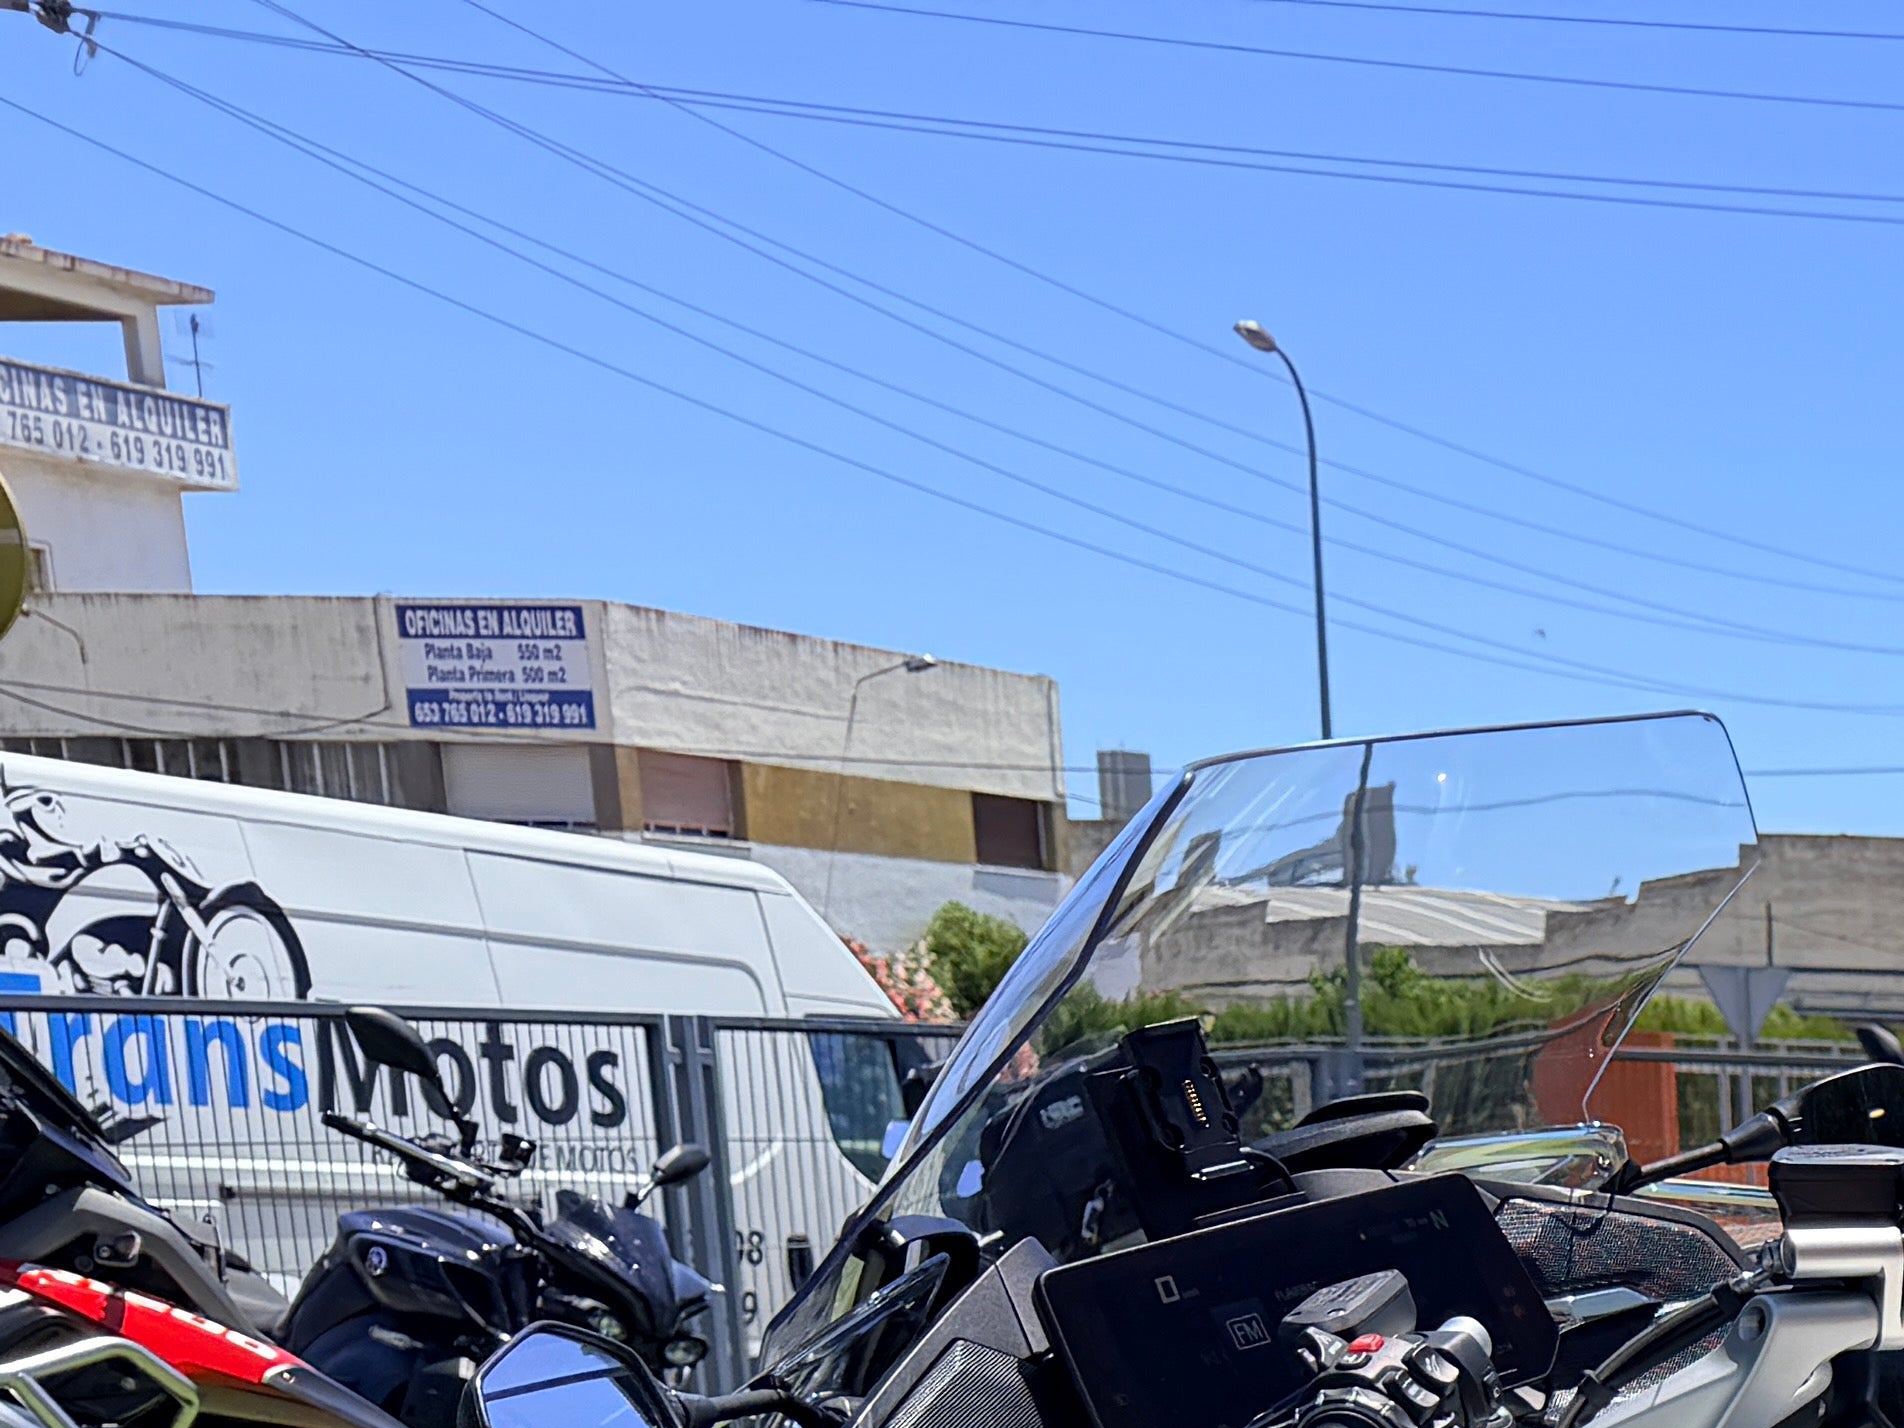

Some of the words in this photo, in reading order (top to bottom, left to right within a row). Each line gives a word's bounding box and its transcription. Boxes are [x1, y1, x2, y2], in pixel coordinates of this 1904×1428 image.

[76, 381, 107, 422] EN
[117, 388, 224, 446] ALQUILER
[7, 410, 44, 445] 765
[53, 419, 90, 453] 012
[111, 431, 145, 465] 619
[153, 439, 186, 472] 319
[194, 447, 226, 481] 991
[404, 609, 475, 636] OFICINAS
[477, 609, 499, 636] EN
[503, 609, 577, 637] ALQUILER
[424, 643, 463, 660] Planta
[466, 643, 493, 664] Baja
[427, 665, 466, 682] Planta
[468, 665, 516, 683] Primera
[414, 702, 440, 723] 653
[442, 702, 468, 723] 765
[470, 703, 496, 724] 012
[506, 703, 532, 724] 619
[534, 703, 560, 725] 319
[562, 703, 587, 725] 991
[1232, 1319, 1264, 1345] FM
